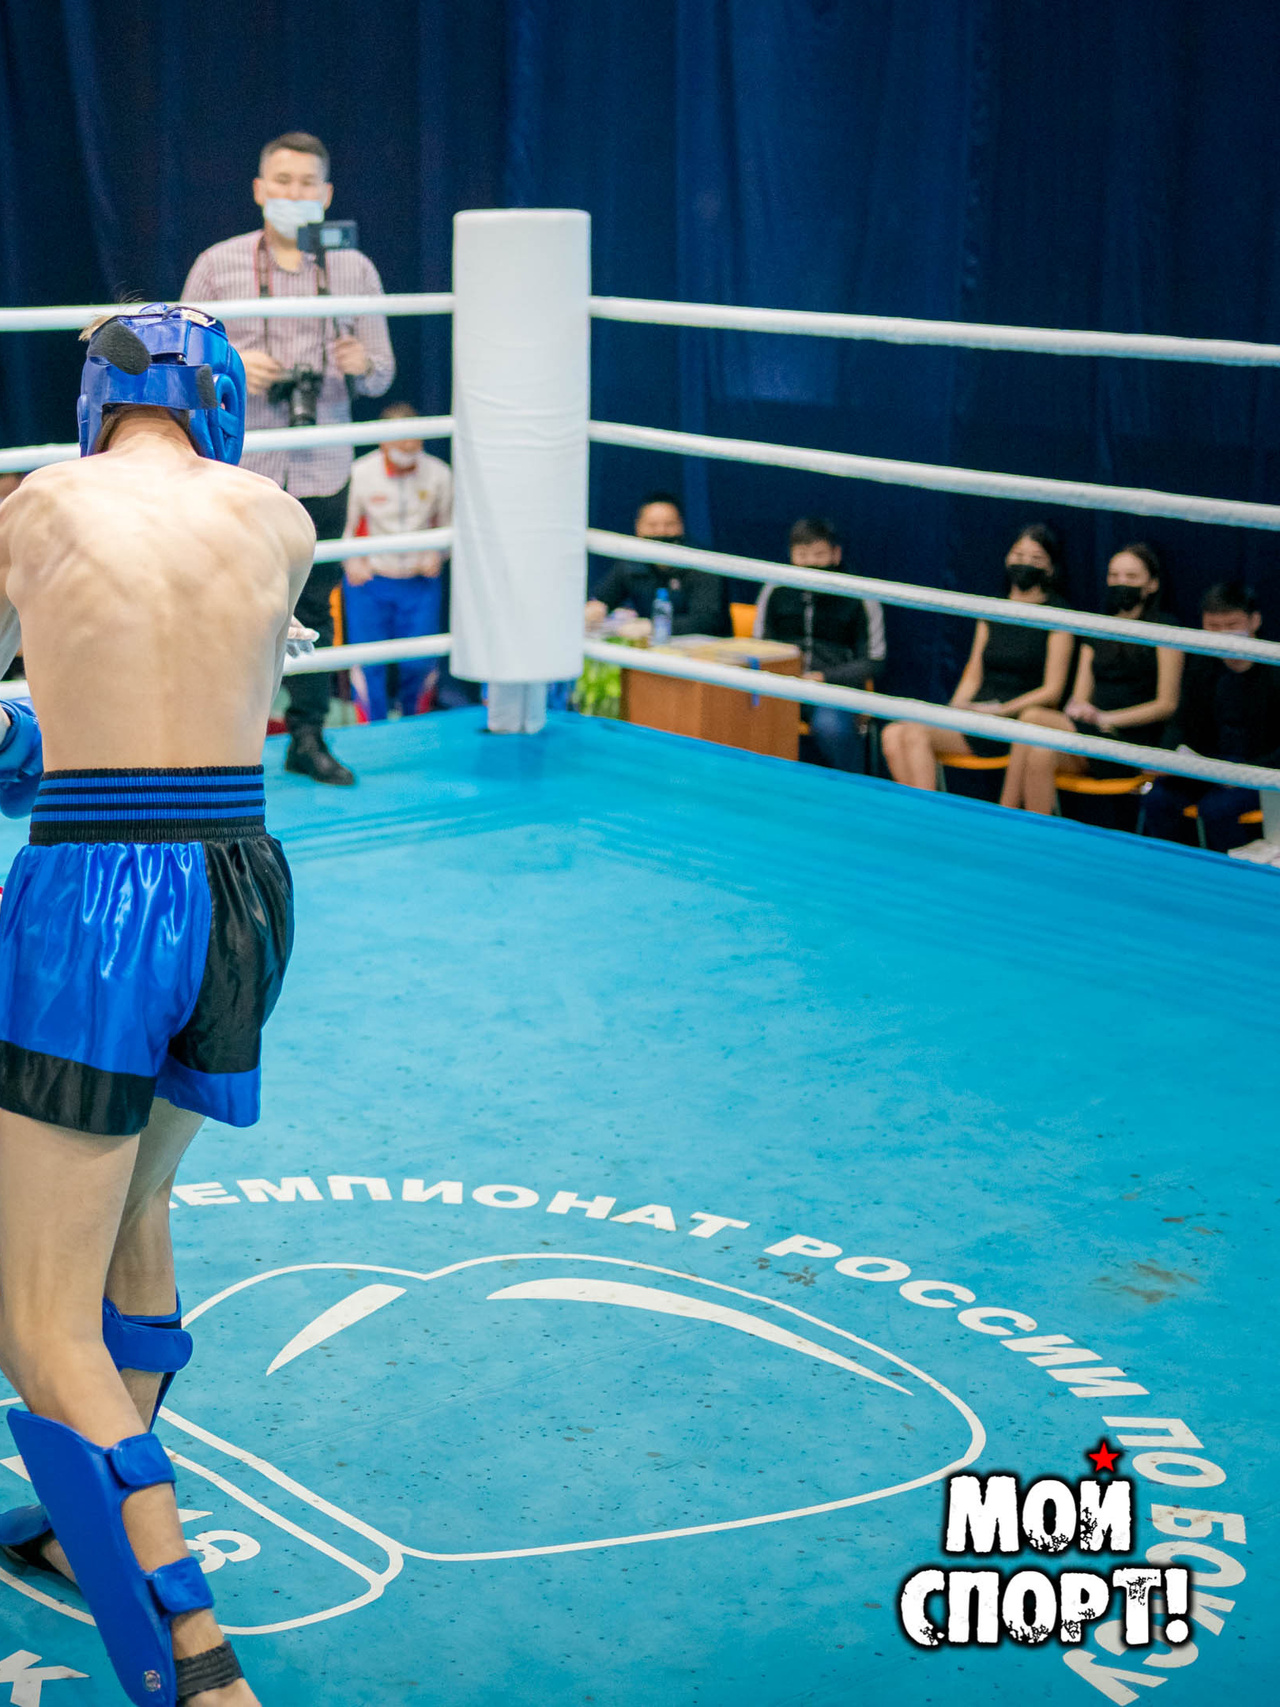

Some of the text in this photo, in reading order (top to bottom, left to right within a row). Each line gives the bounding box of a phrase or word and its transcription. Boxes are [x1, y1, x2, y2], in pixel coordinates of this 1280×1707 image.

[168, 1175, 751, 1239] ЕМПИОНАТ
[763, 1234, 1151, 1398] РОССИИ
[1101, 1416, 1227, 1489] ПО
